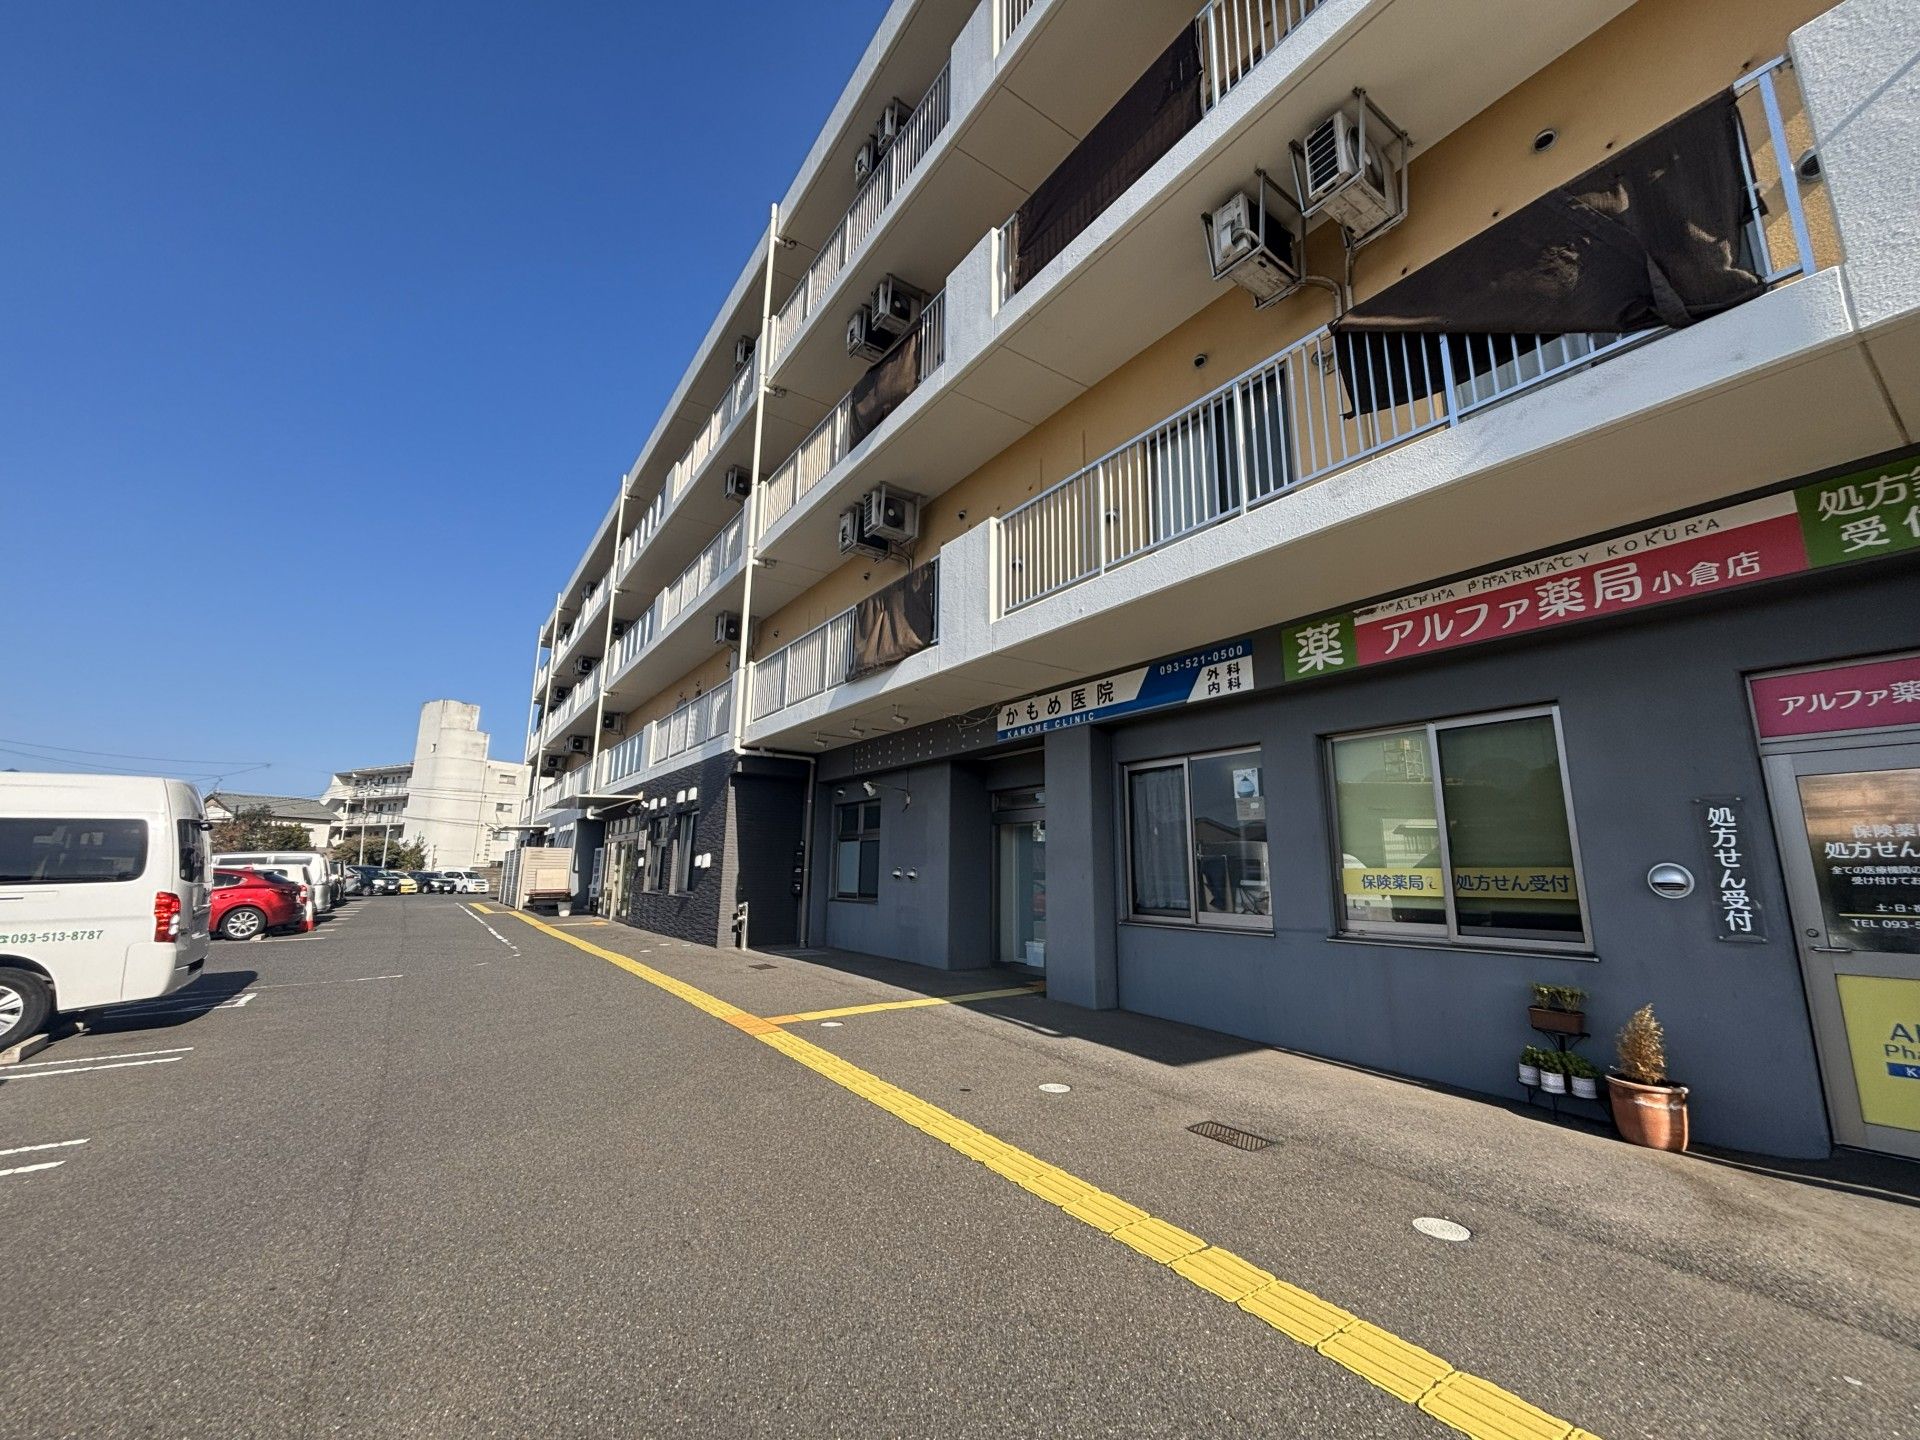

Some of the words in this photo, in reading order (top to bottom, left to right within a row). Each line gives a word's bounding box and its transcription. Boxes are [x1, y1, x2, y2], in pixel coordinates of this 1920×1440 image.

[1394, 589, 1456, 612] ALPHA
[1467, 552, 1589, 593] PHARMACY
[1606, 518, 1720, 557] KOKURA
[1159, 645, 1243, 676] 093-521-0500
[1296, 622, 1345, 674] 薬
[1006, 681, 1114, 726] かもめ医院
[1007, 723, 1049, 738] KAMOME
[1054, 712, 1095, 728] CLINIC
[1852, 823, 1920, 838] 保険薬
[1707, 807, 1753, 932] 処方せん受付
[1362, 874, 1424, 891] 保険薬局
[1456, 874, 1570, 893] 処方せん受付
[1851, 918, 1879, 928] TEL
[11, 930, 104, 944] 093-513-8787
[1885, 1044, 1920, 1060] Ph
